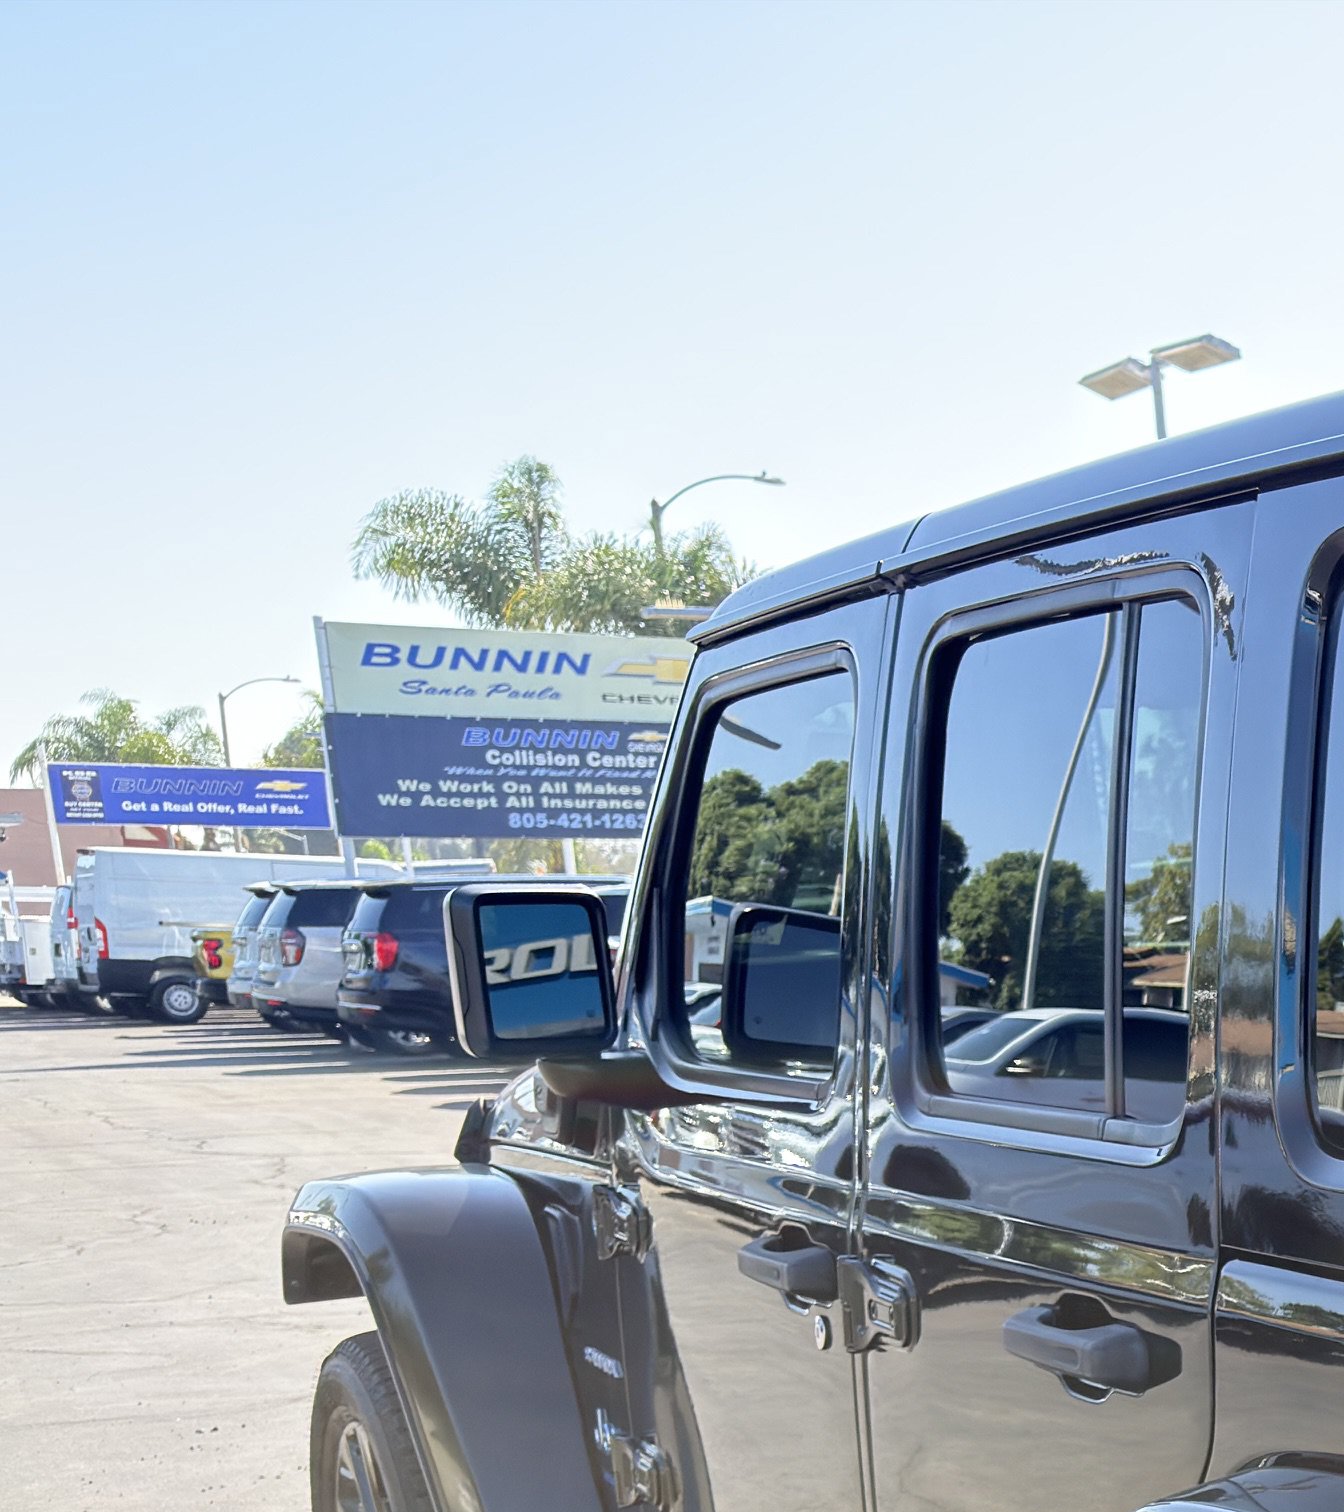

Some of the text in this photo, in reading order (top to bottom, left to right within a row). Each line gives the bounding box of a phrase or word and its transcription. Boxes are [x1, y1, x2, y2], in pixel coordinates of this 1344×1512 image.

[360, 642, 592, 676] BUNNIN
[399, 679, 562, 701] Santa Paula
[461, 726, 620, 750] BUNNIN
[485, 749, 657, 768] Collision Center
[111, 777, 243, 796] BUNNIN
[397, 779, 643, 795] We Work On All Makes
[122, 800, 304, 815] Get a Real Offer, Real Fast.
[377, 794, 647, 810] We Accept All Insurance
